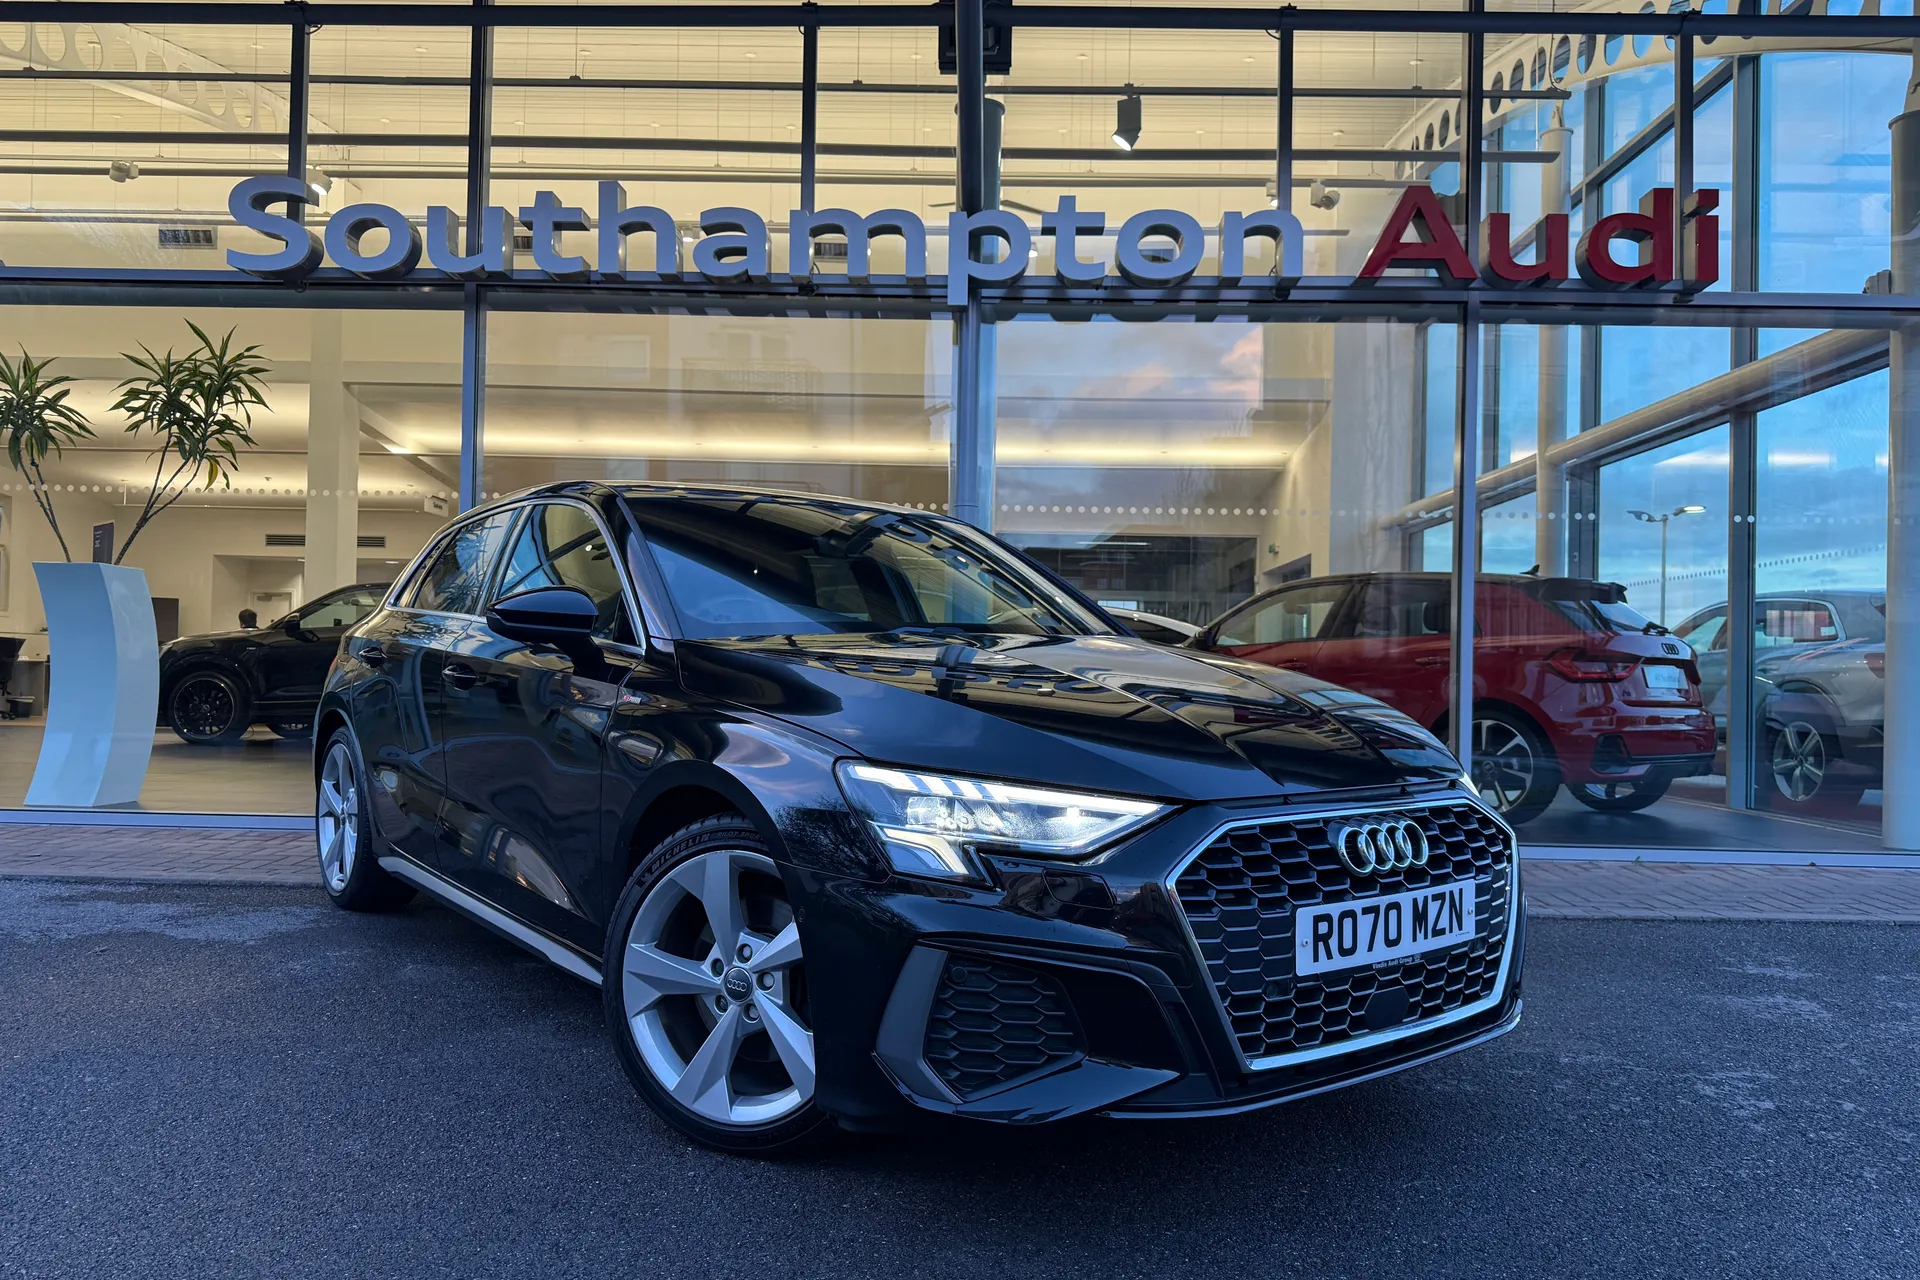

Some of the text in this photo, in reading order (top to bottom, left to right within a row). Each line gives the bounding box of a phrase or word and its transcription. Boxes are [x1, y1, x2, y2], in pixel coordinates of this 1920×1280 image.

[227, 175, 1720, 306] Southampton Audi
[651, 832, 711, 873] MICHELIN
[1312, 887, 1464, 963] RO70 MZN
[1388, 958, 1399, 967] Audi
[1399, 956, 1413, 965] Group
